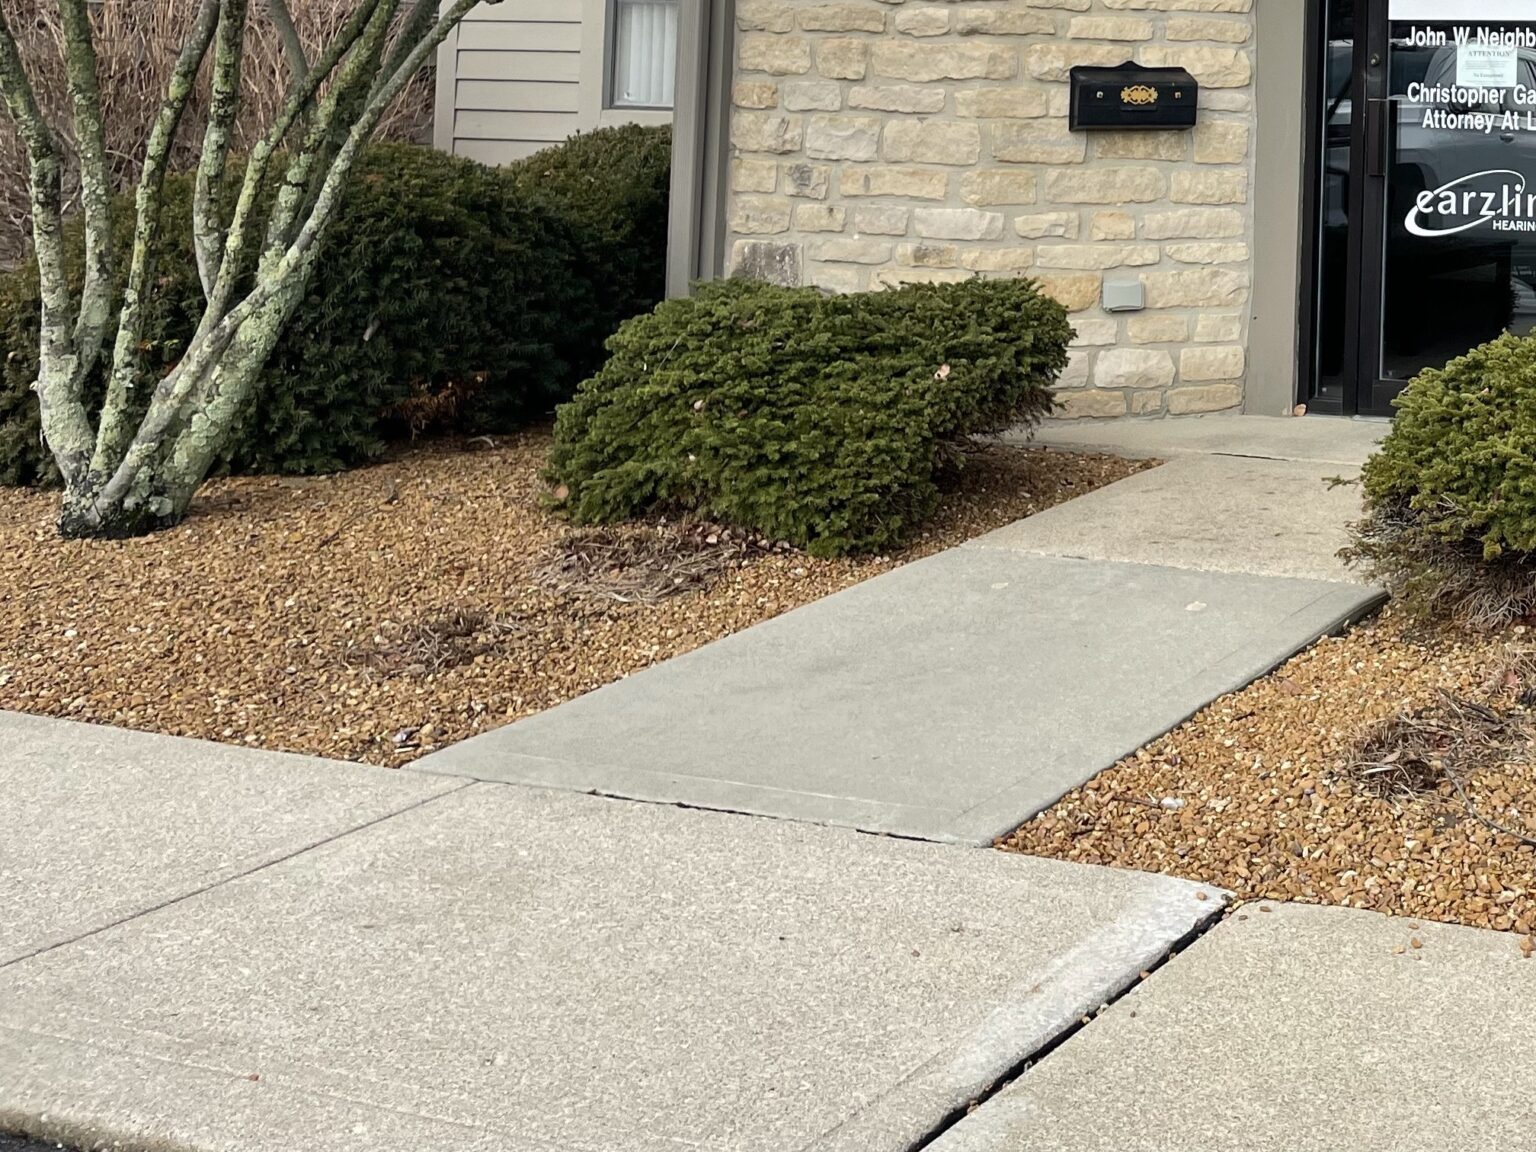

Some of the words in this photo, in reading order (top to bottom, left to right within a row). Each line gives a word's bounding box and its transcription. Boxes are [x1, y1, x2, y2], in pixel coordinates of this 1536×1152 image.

[1406, 26, 1446, 47] John
[1453, 27, 1471, 46] W
[1407, 82, 1507, 108] Christopher
[1422, 108, 1495, 133] Attorney
[1501, 110, 1520, 130] At
